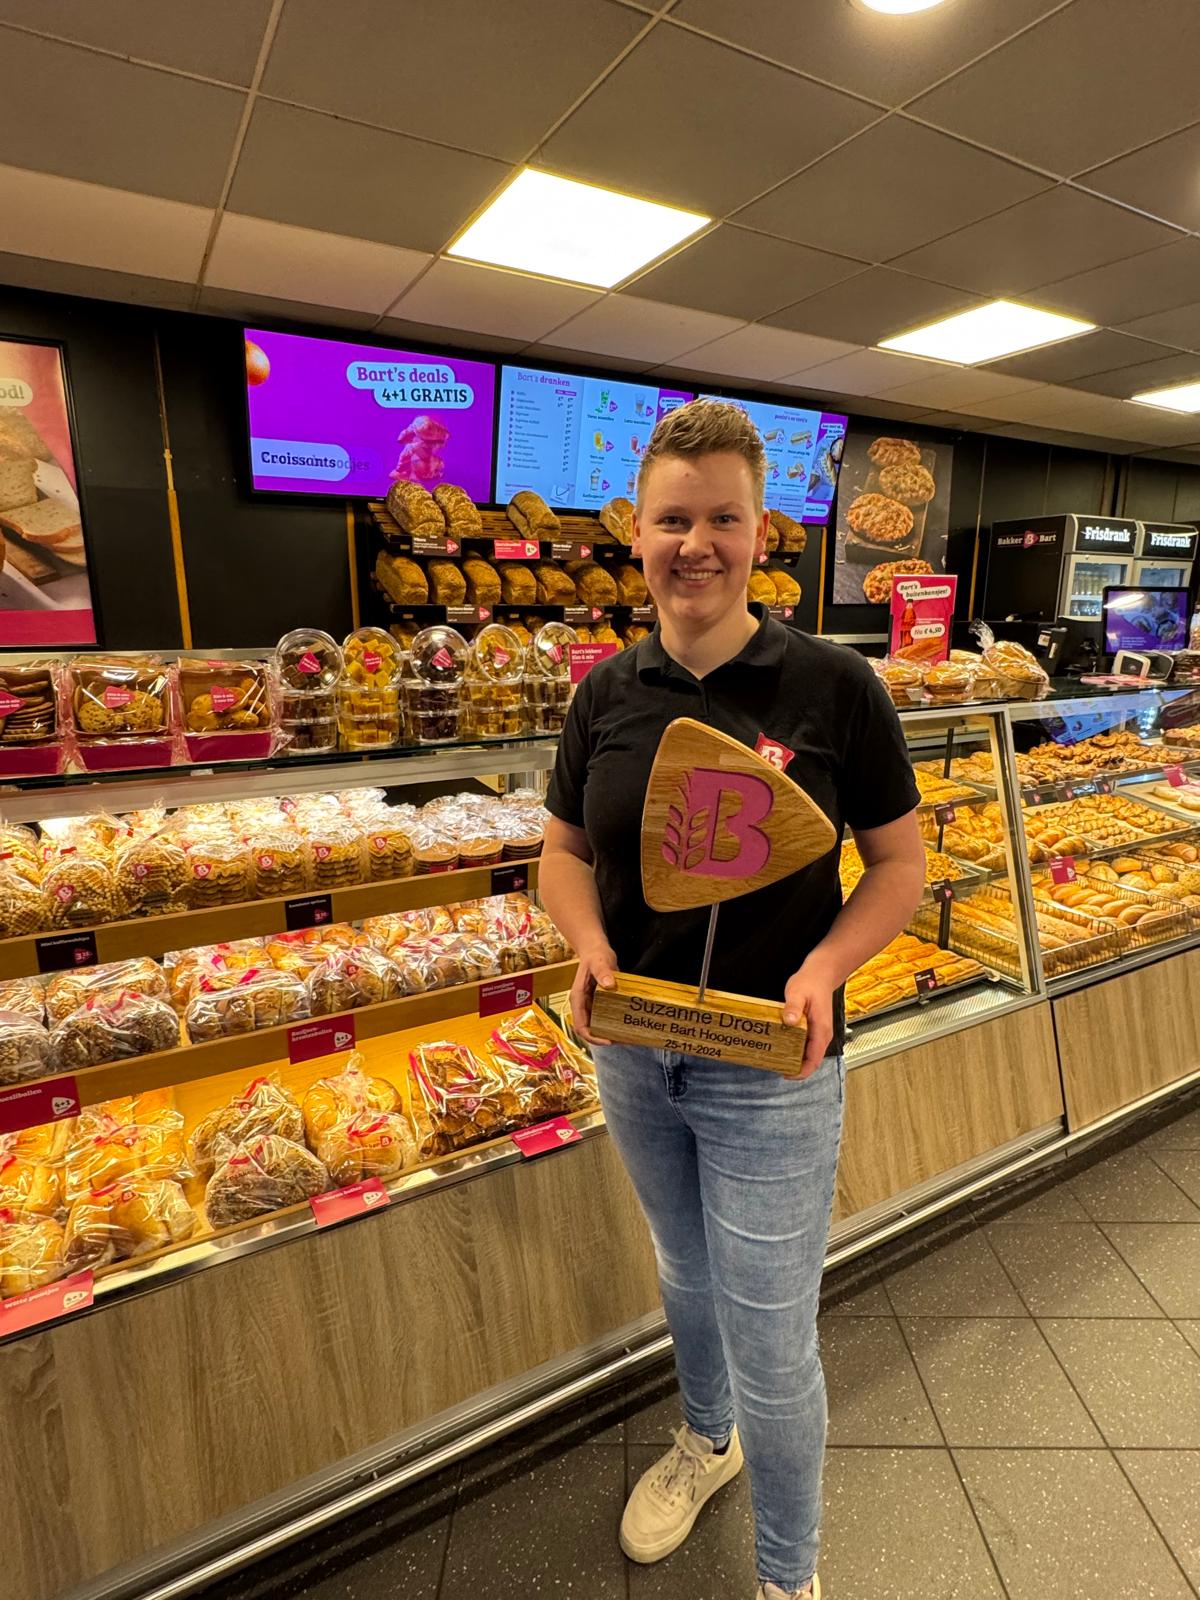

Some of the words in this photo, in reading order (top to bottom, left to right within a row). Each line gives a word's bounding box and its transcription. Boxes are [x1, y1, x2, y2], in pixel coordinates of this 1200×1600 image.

[357, 366, 405, 382] Bart's
[409, 368, 449, 383] deals
[539, 375, 571, 387] dranken
[382, 388, 407, 401] 4+1
[411, 388, 468, 403] GRATIS
[260, 451, 336, 469] Croissants
[998, 536, 1022, 546] Bakker
[1039, 534, 1057, 543] Bart
[1085, 526, 1130, 543] Frisdrank
[1150, 532, 1191, 548] Frisdrank
[900, 583, 918, 591] Bart's
[761, 745, 784, 770] B
[672, 767, 774, 878] B
[629, 996, 713, 1024] Suzanne
[719, 1012, 771, 1036] Drost
[336, 1034, 349, 1042] 4+1
[623, 1013, 666, 1032] Bakker
[670, 1022, 696, 1037] Bart
[699, 1028, 772, 1051] Hoogeveen
[664, 1039, 722, 1057] 25-11-2024
[54, 1099, 71, 1108] 4+1
